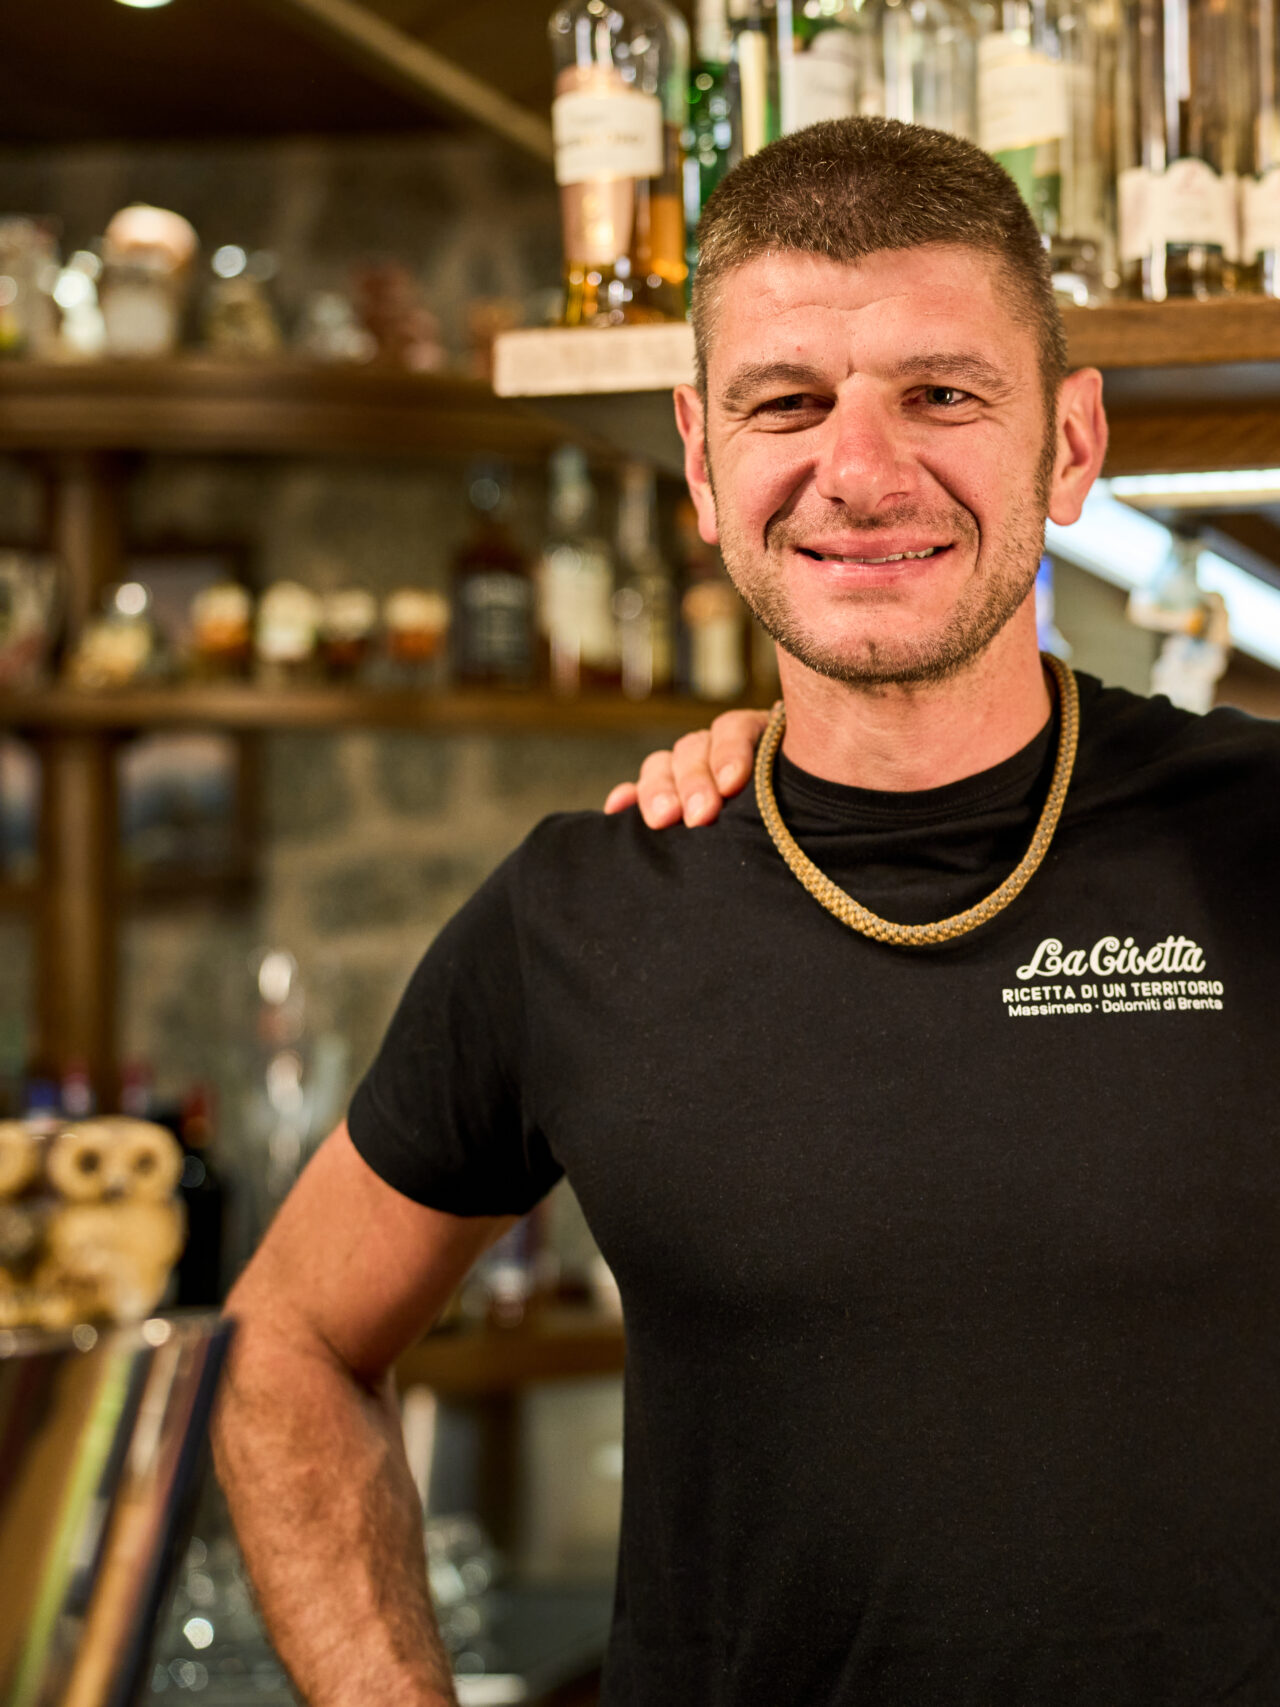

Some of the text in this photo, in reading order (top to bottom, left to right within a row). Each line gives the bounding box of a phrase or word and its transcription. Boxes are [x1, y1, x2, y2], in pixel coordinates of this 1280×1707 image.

[1016, 938, 1089, 980] La
[1002, 980, 1224, 1003] RICETTA DI UN TERRITORIO
[1008, 996, 1224, 1017] Massimeno Dolomiti di Brenta
